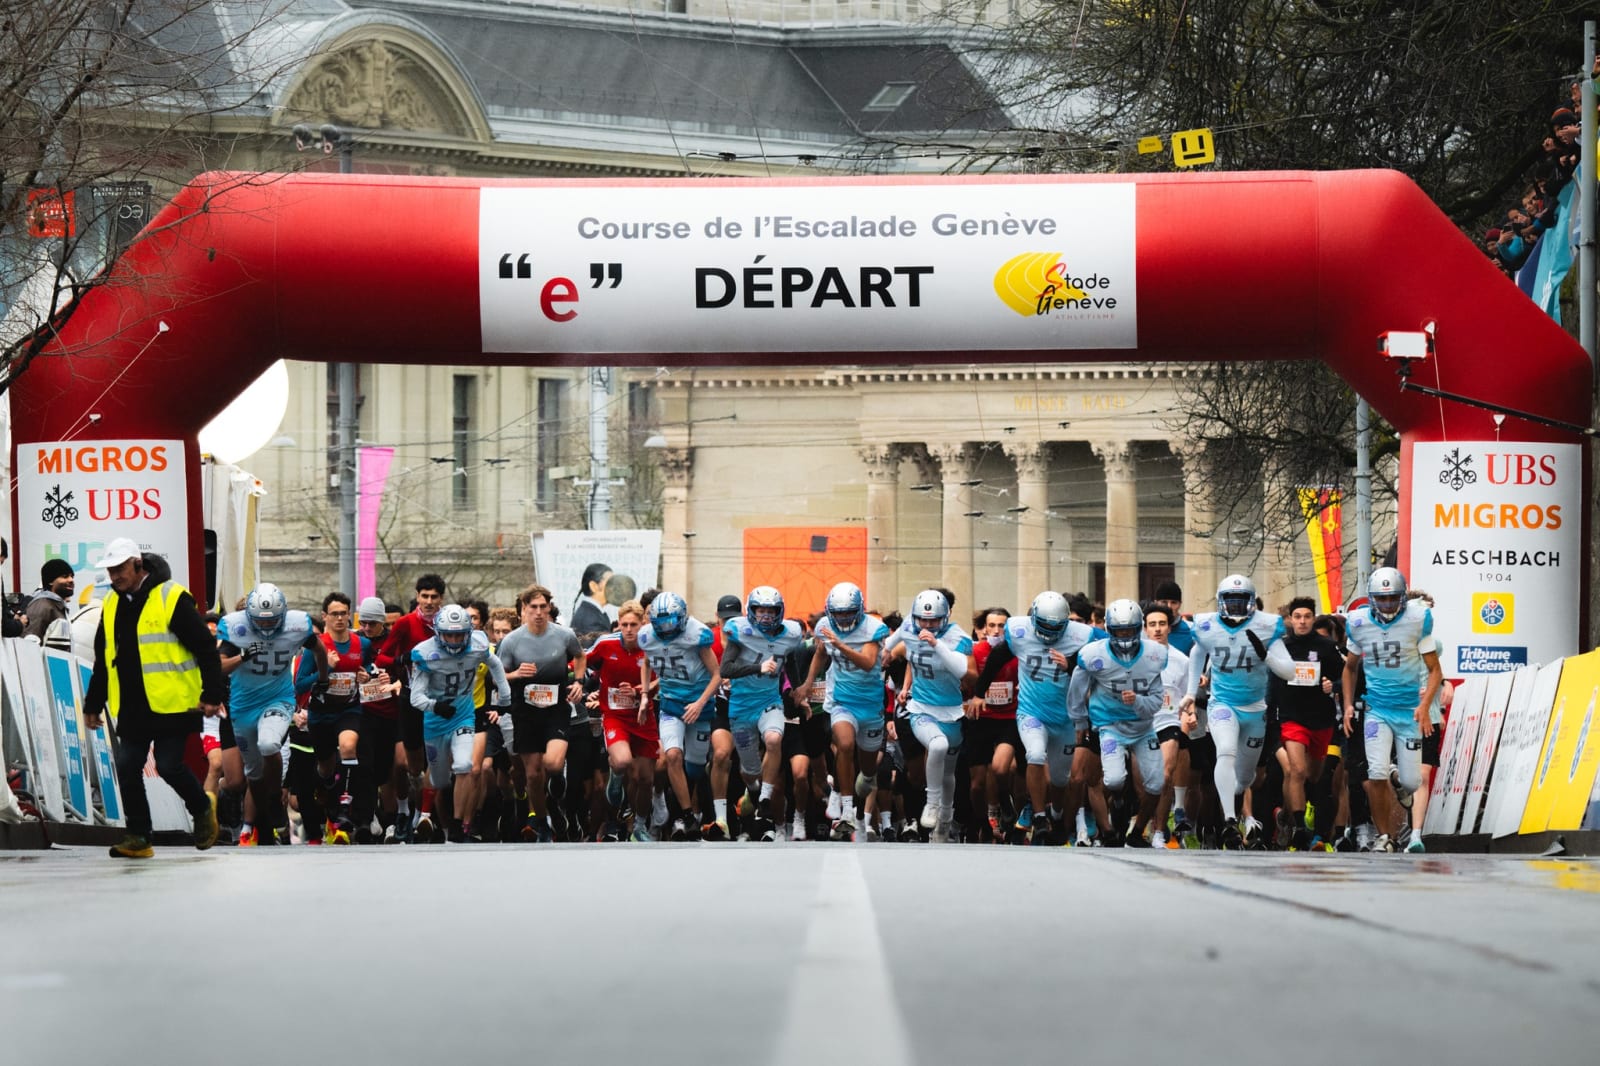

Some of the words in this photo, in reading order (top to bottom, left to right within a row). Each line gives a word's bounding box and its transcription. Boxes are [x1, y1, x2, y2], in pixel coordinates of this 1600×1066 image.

[578, 217, 690, 239] Course
[704, 216, 742, 238] de
[754, 216, 917, 238] l’Escalade
[932, 212, 1057, 236] Genève
[695, 255, 934, 309] DÉPART
[1044, 262, 1110, 290] Stade
[1037, 284, 1117, 315] Genève
[38, 446, 168, 474] MIGROS
[1485, 454, 1557, 486] UBS
[85, 488, 162, 521] UBS
[1434, 503, 1562, 531] MIGROS
[1432, 550, 1560, 567] AESCHBACH
[1479, 573, 1512, 582] 1904
[1214, 646, 1254, 674] 24
[1372, 641, 1400, 668] 13
[1460, 647, 1511, 660] Tribune
